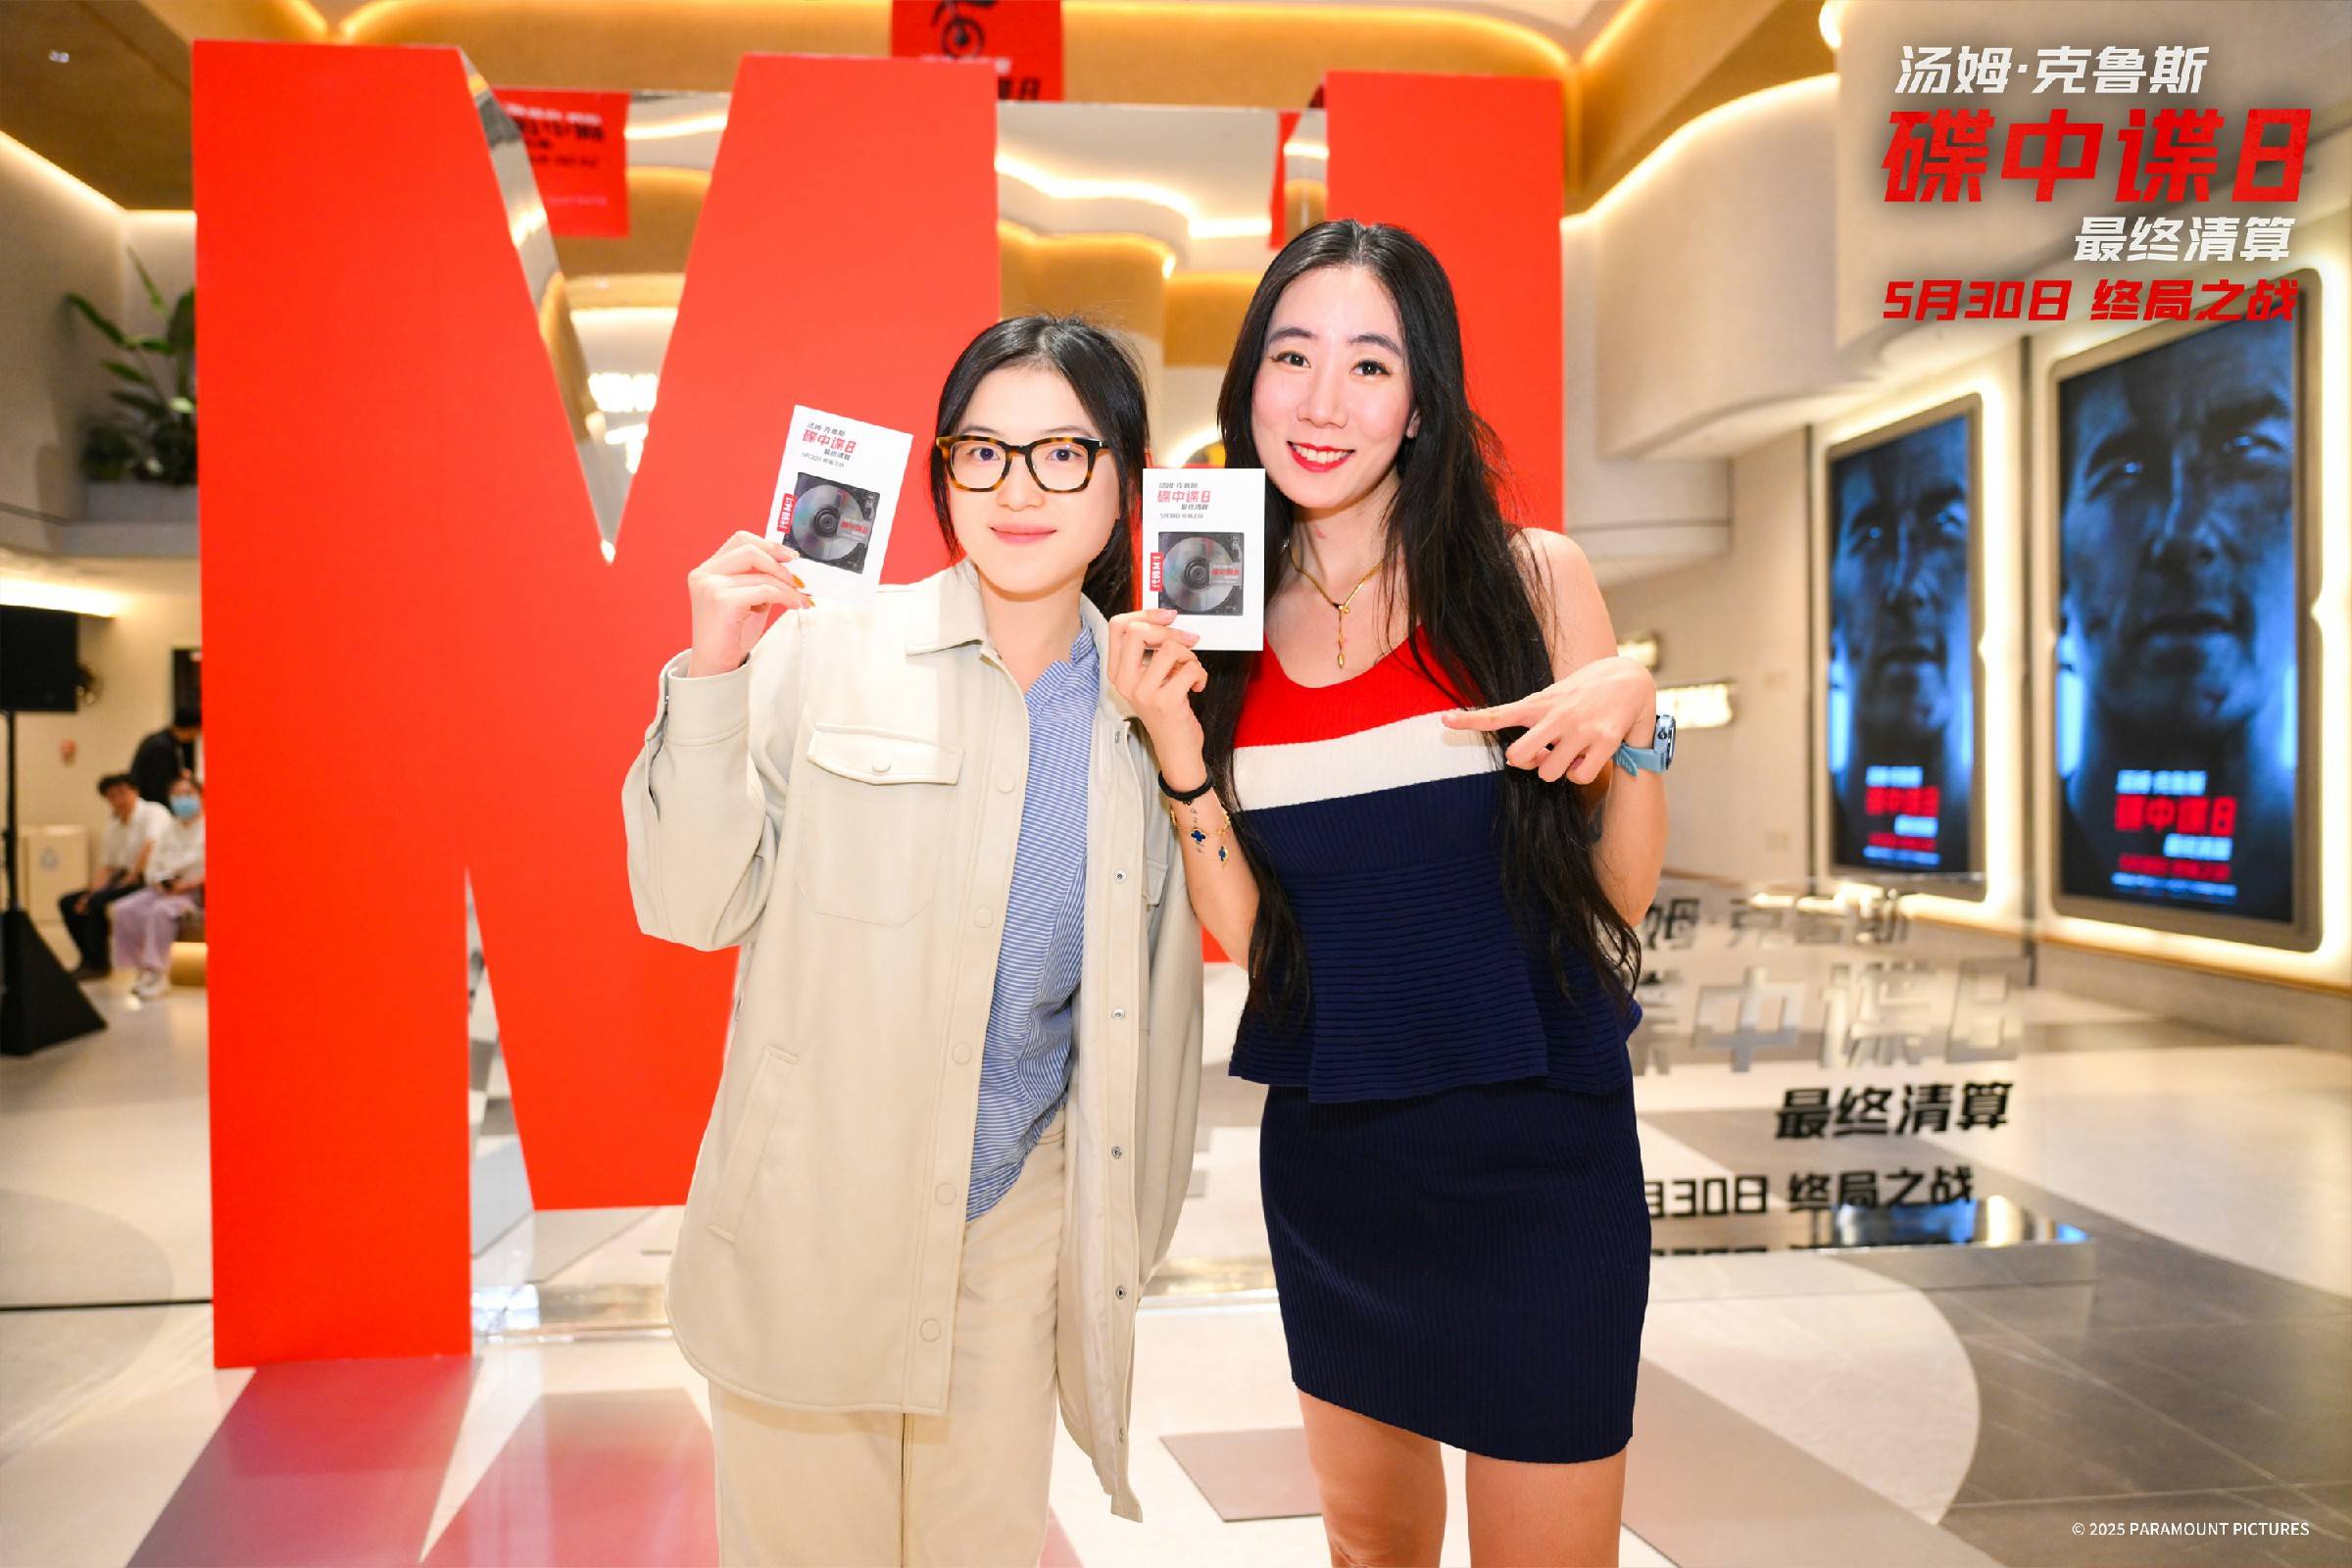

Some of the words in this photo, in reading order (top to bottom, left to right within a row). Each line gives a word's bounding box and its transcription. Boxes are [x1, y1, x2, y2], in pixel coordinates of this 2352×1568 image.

[1157, 490, 1211, 503] 碟中谍8
[1775, 1081, 2013, 1140] 最终清算
[1788, 1166, 1975, 1212] 终局之战
